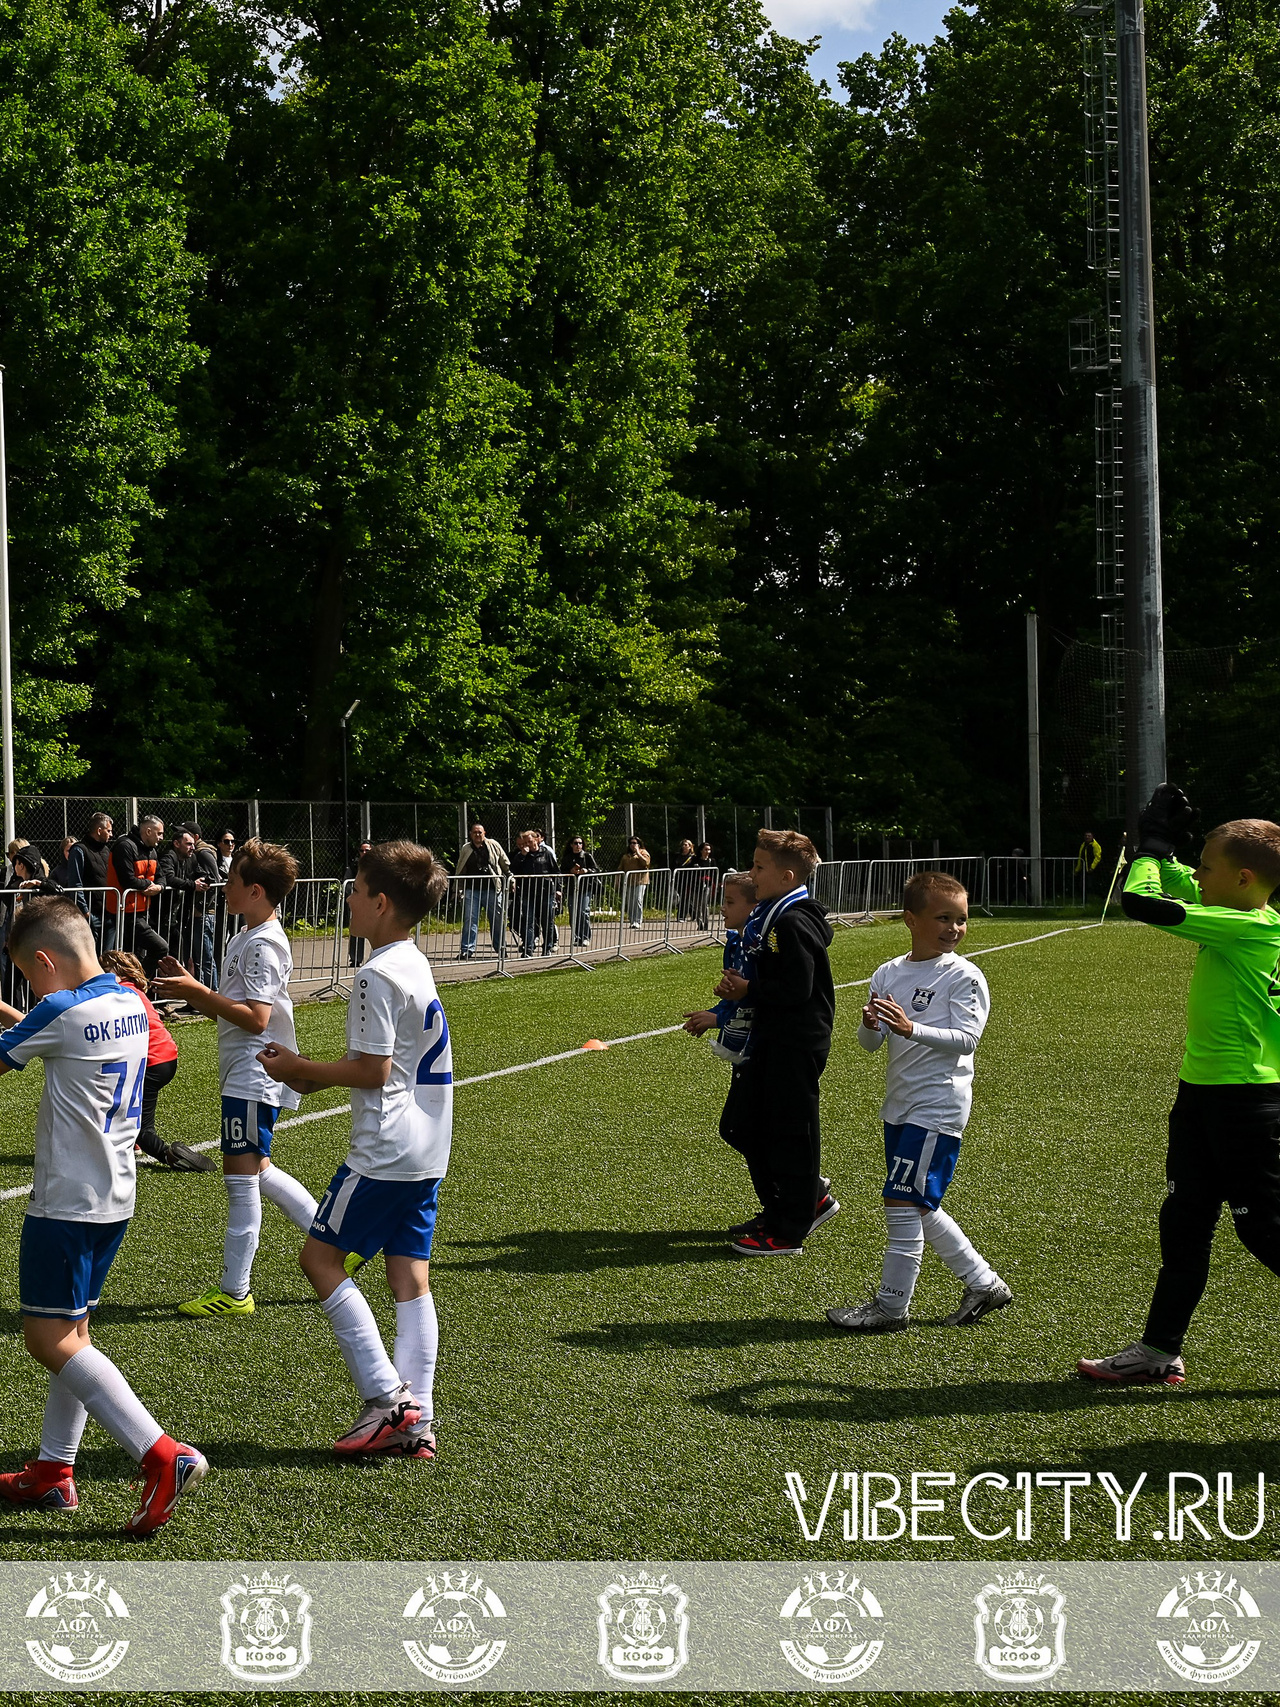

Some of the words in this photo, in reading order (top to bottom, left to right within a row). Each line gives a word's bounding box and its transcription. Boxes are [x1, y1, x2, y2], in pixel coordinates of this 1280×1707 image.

[83, 1021, 111, 1043] ФК
[102, 1057, 146, 1134] 74
[223, 1117, 243, 1141] 16
[892, 1183, 913, 1193] JAKO
[880, 1285, 904, 1298] JAKO
